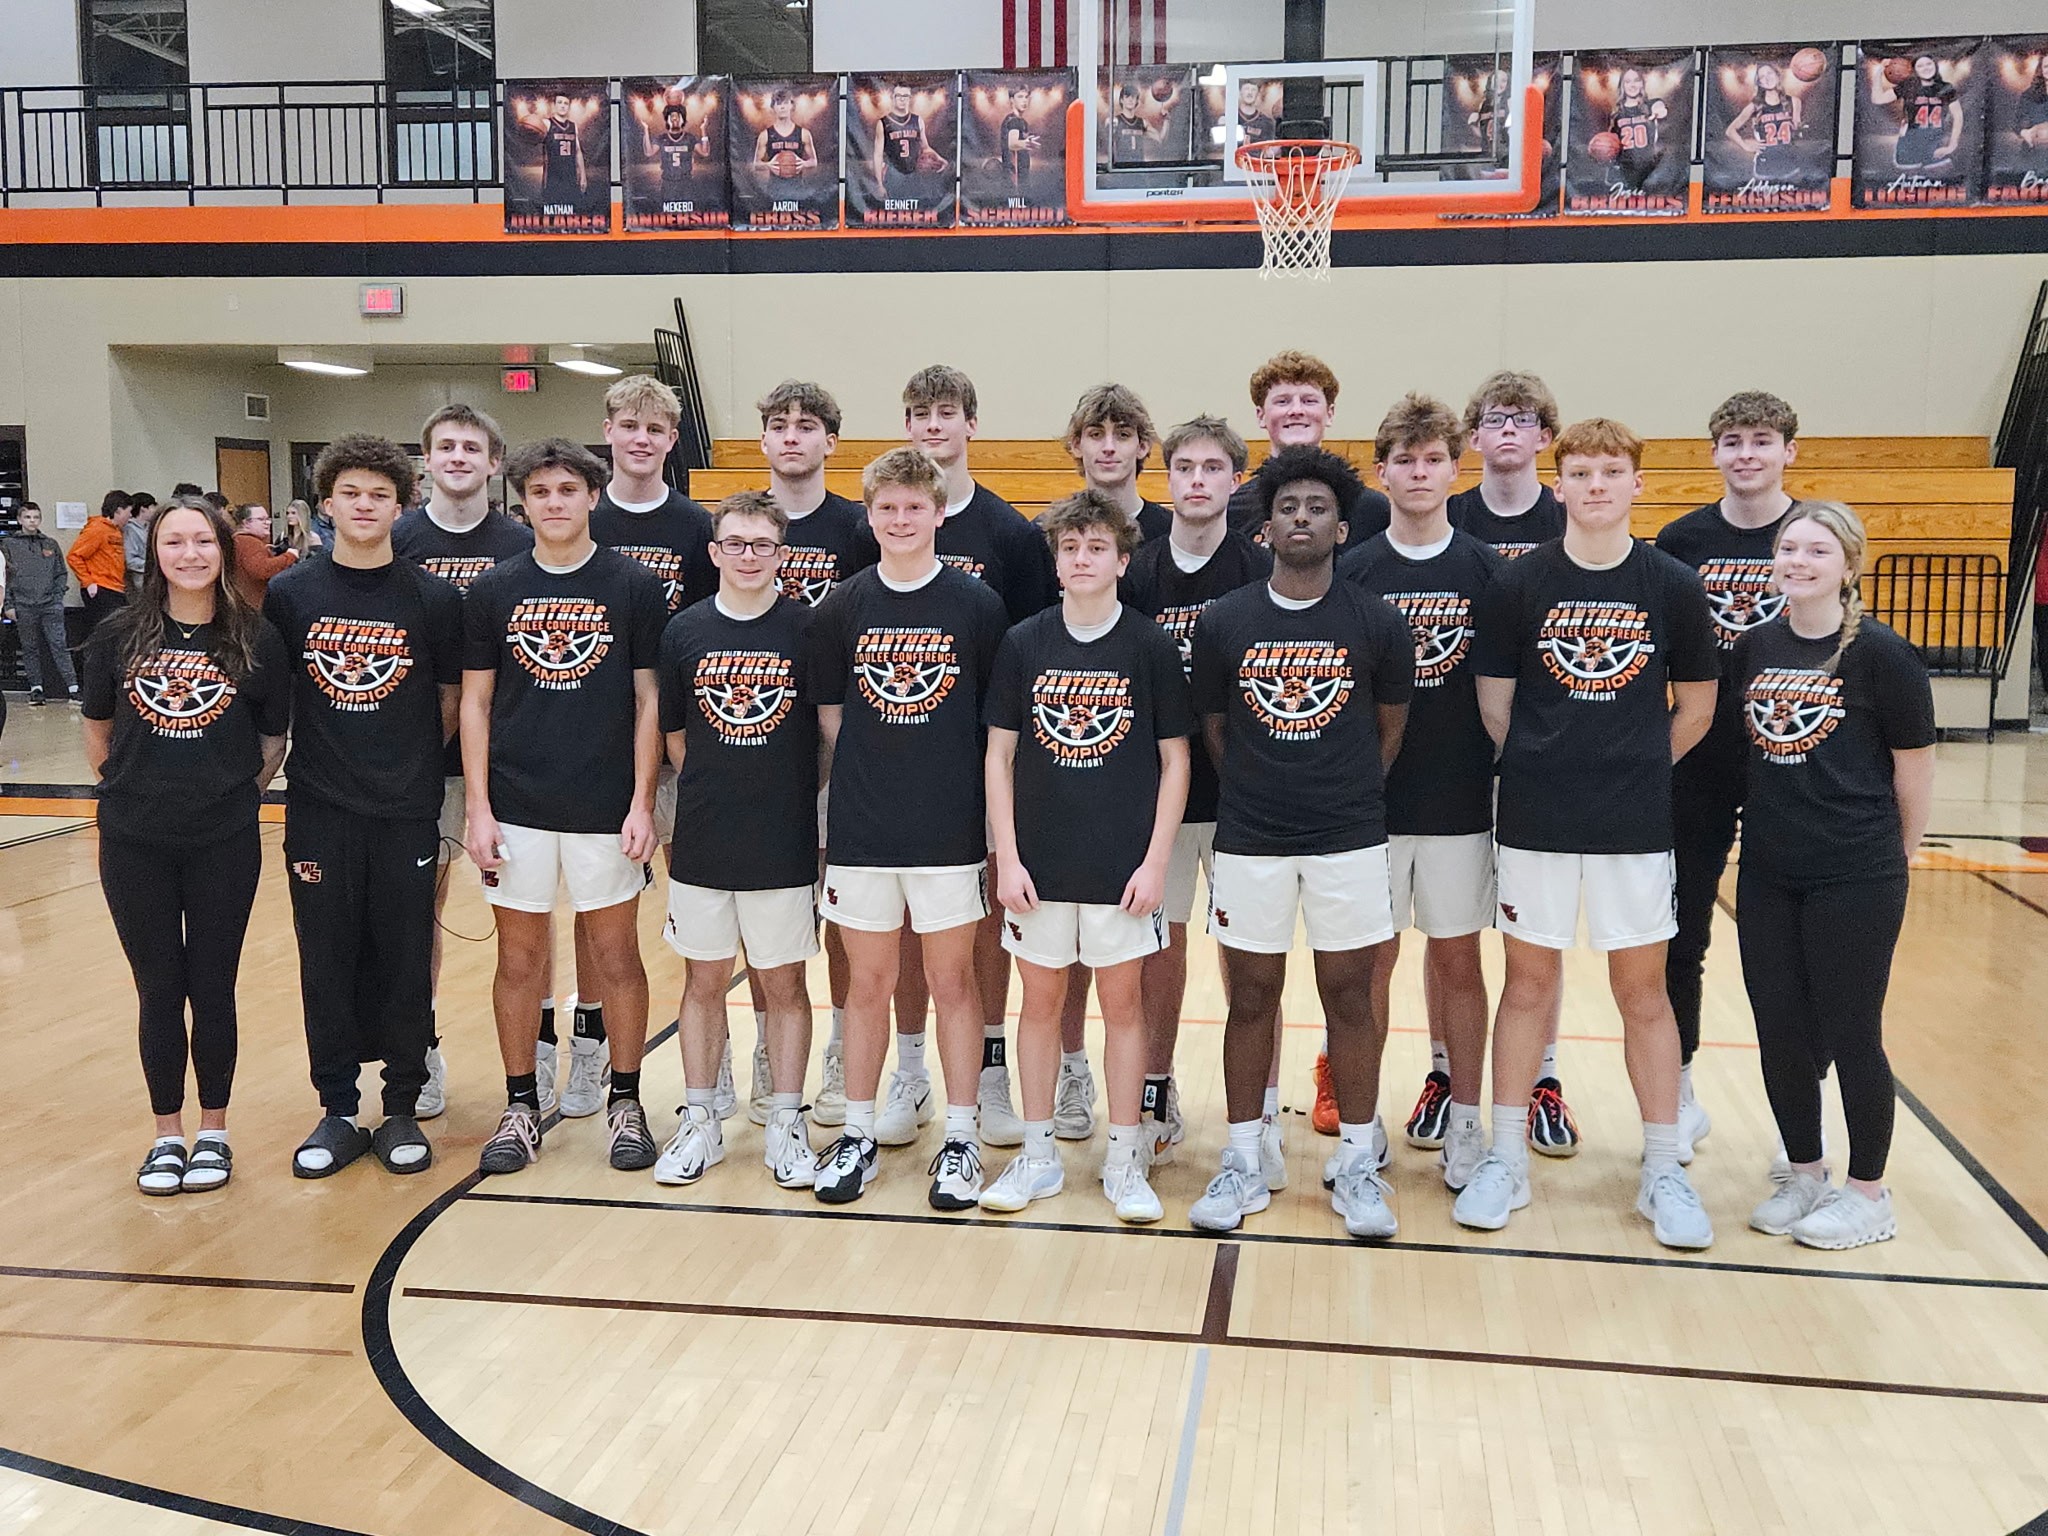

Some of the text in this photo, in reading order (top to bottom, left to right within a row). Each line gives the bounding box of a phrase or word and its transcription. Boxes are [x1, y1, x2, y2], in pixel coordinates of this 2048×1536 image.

[1914, 105, 1943, 128] 44
[1621, 122, 1648, 144] 20
[1764, 121, 1791, 146] 24
[560, 141, 571, 156] 21
[900, 139, 909, 157] 3
[673, 152, 681, 167] 5
[885, 199, 919, 210] BENNETT
[1008, 197, 1027, 208] WILL
[1708, 189, 1827, 207] FERGUSON
[543, 204, 573, 215] NATHAN
[663, 201, 693, 213] MEKEBO
[772, 201, 799, 212] AARON
[626, 211, 729, 226] ANDERSON
[966, 207, 1064, 222] SCHMIDT
[511, 604, 607, 622] PANTHERS
[1544, 608, 1649, 629] PANTHERS
[507, 621, 610, 632] COULEE CONFERENCE
[1408, 615, 1474, 627] CONFERENCE
[306, 622, 407, 646] PANTHERS
[1540, 626, 1652, 641] COULEE CONFERENCE
[343, 642, 411, 656] CONFERENCE
[856, 634, 954, 653] PANTHERS
[512, 643, 609, 681] CHAMPIONS
[892, 652, 957, 664] CONFERENCE
[1242, 647, 1348, 667] PANTHERS
[696, 656, 792, 677] PANTHERS
[1239, 666, 1353, 678] COULEE CONFERENCE
[1542, 651, 1649, 691] CHAMPIONS
[307, 662, 408, 703] CHAMPIONS
[539, 679, 581, 690] STRAIGHT
[693, 674, 796, 687] COULEE CONFERENCE
[1032, 675, 1130, 696] PANTHERS
[858, 674, 956, 716] CHAMPIONS
[1034, 693, 1133, 707] OULEE CONFERENCE
[1774, 690, 1844, 707] CONFERENCE
[128, 690, 232, 730] CHAMPIONS
[335, 701, 380, 712] STRAIGHT
[1244, 689, 1350, 732] CHAMPIONS
[698, 698, 793, 738] CHAMPIONS
[886, 713, 930, 724] STRAIGHT
[158, 728, 203, 739] STRAIGHT
[724, 735, 768, 746] STRAIGHT
[1275, 729, 1321, 741] STRAIGHT
[1060, 757, 1104, 768] STRAIGHT
